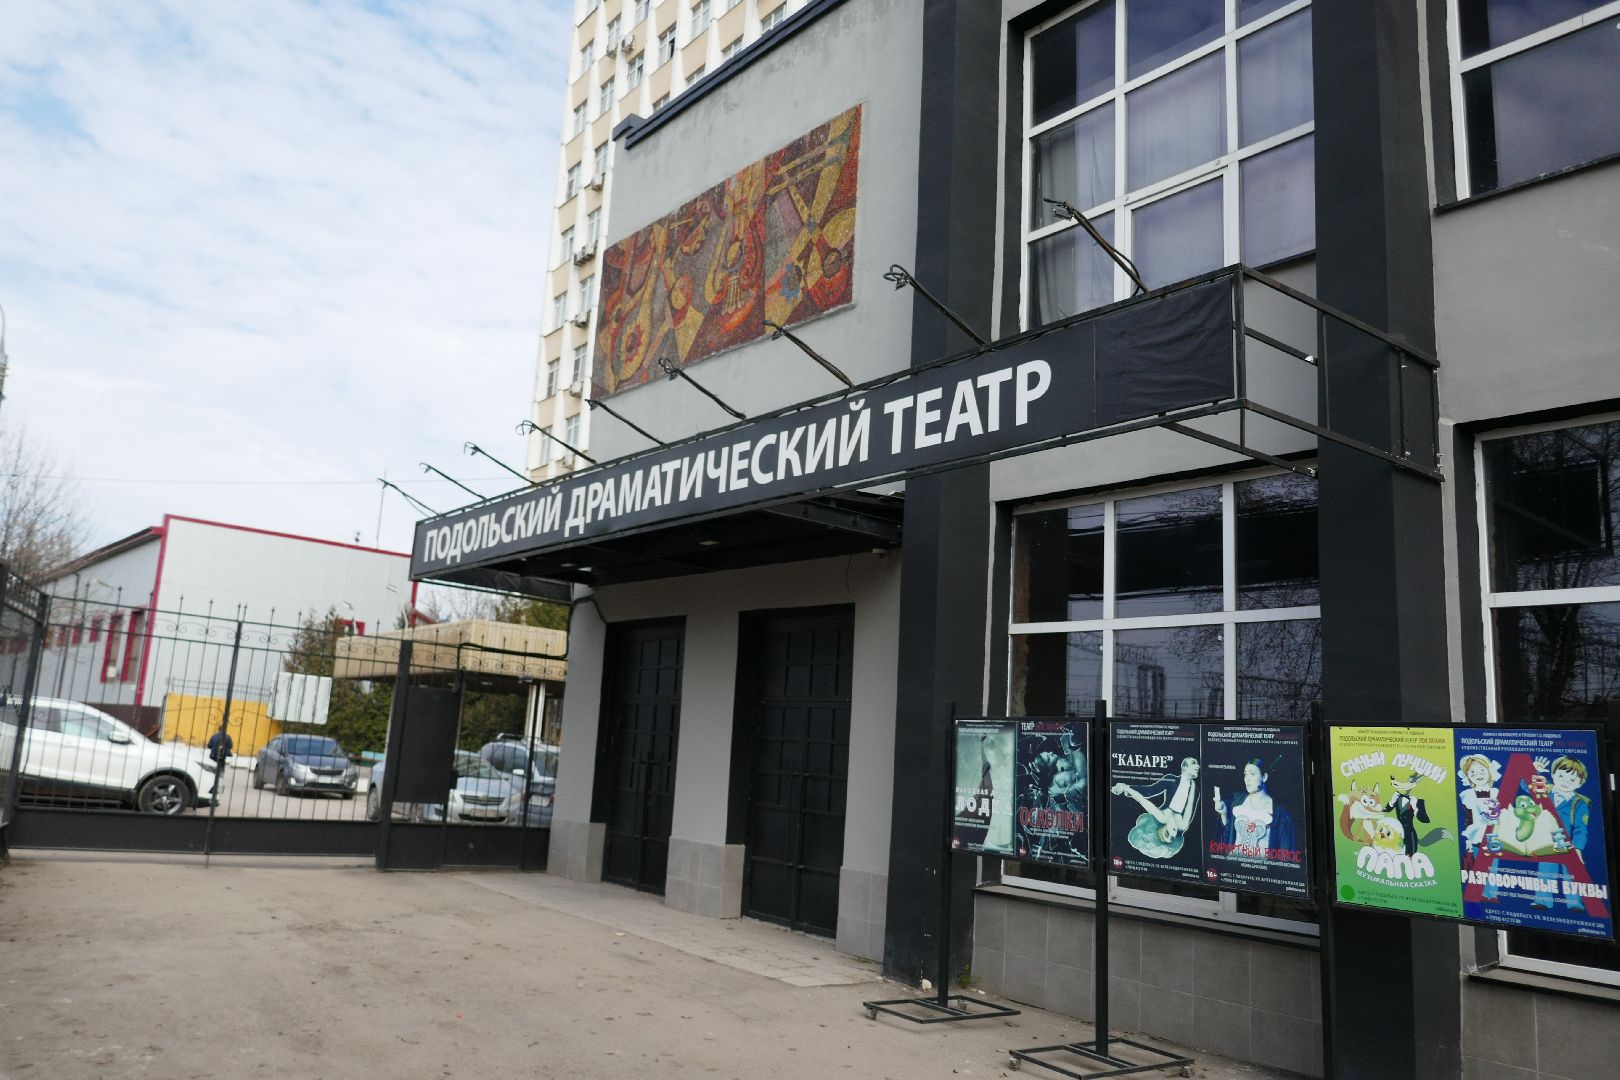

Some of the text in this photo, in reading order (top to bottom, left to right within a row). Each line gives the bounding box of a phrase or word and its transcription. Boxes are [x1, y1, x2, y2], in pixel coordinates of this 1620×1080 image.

[424, 360, 1052, 564] ПОДОЛЬСКИЙ ДРАМАТИЧЕСКИЙ ТЕАТР
[1461, 737, 1494, 746] ПОДОЛЬСКИЙ
[1494, 738, 1538, 748] ДРАМАТИЧЕСКИЙ
[1340, 748, 1448, 784] САМЫЙ ЛУЧШИЙ
[1020, 806, 1084, 832] ОСКОЛКИ
[1210, 840, 1261, 857] КУРОРТНЫЙ
[1264, 848, 1304, 863] ВОПРОС
[1356, 846, 1435, 880] ПАПА
[1206, 870, 1218, 878] 16+
[1357, 869, 1438, 888] МУЗЫКАЛЬНАЯ СКАЗКА
[1461, 869, 1559, 894] РАЗГОВОРЧИВЫЕ
[1562, 880, 1608, 899] БУКВЫ
